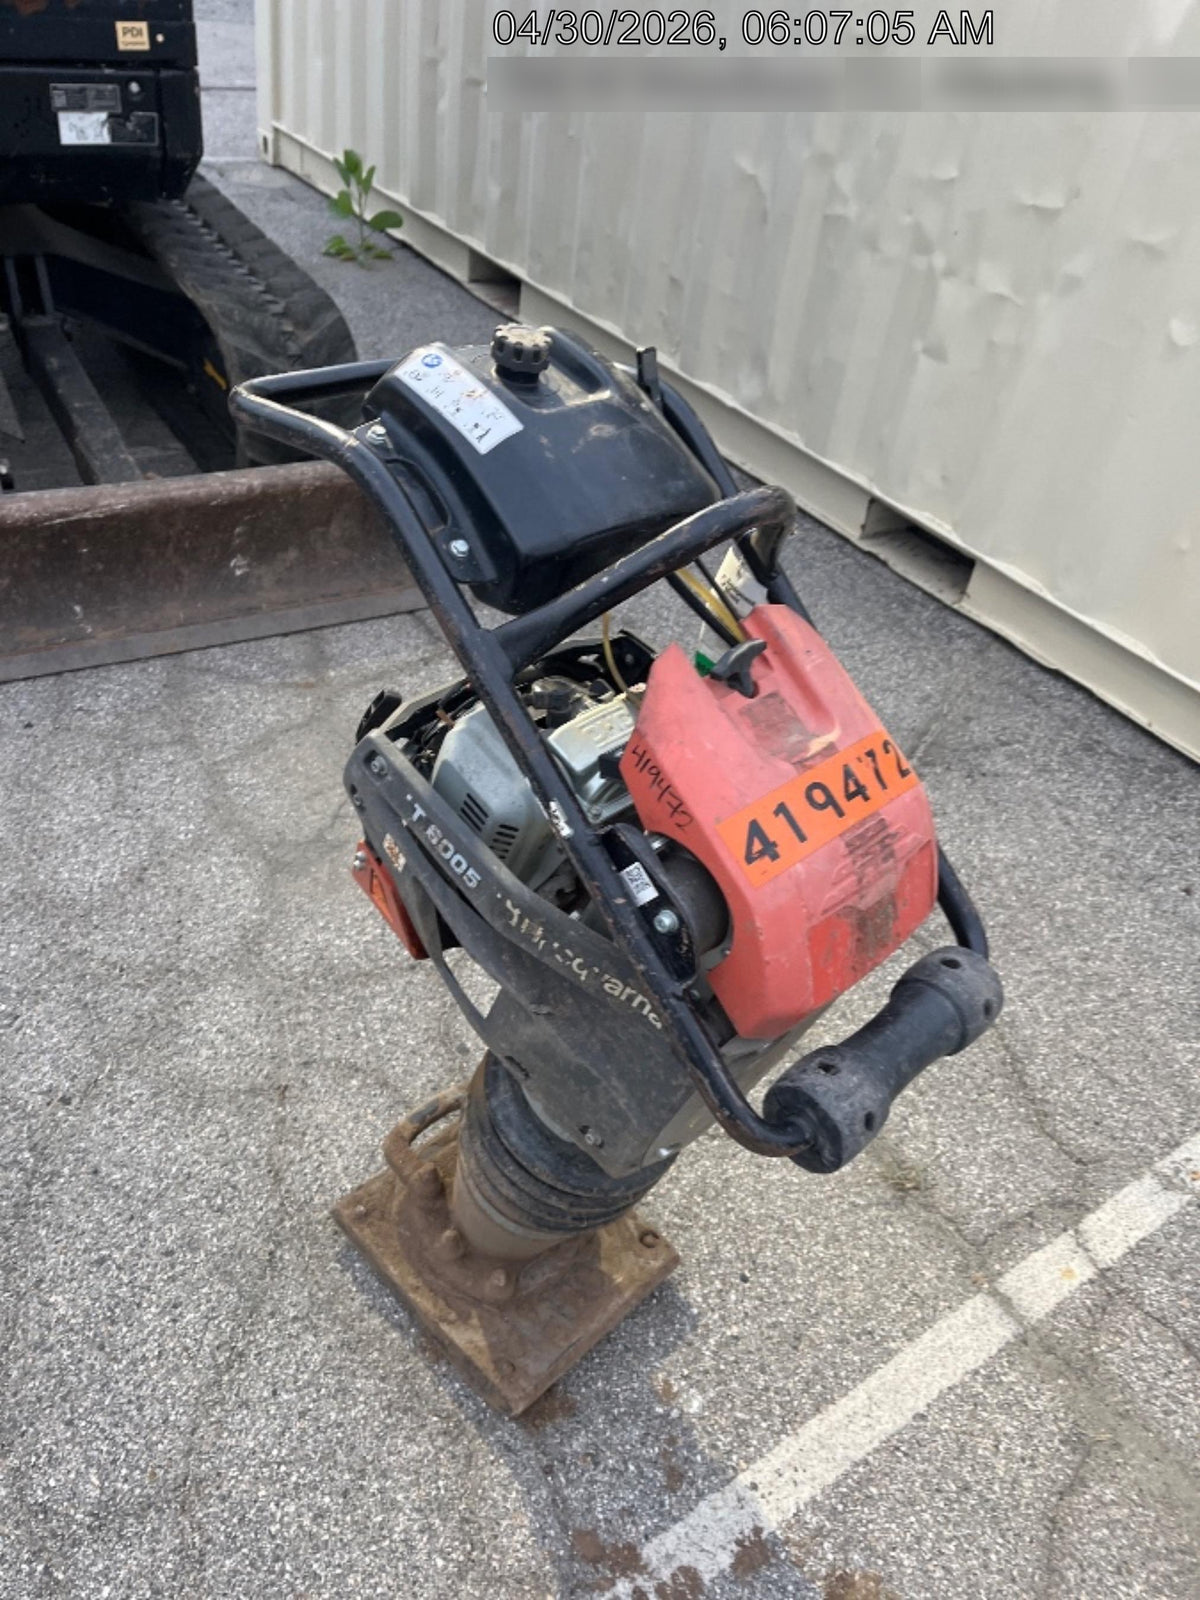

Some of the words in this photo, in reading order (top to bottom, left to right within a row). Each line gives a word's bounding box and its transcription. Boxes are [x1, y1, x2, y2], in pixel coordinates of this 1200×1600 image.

[121, 26, 144, 39] PDI
[631, 744, 695, 831] 419472
[743, 738, 912, 867] 419472
